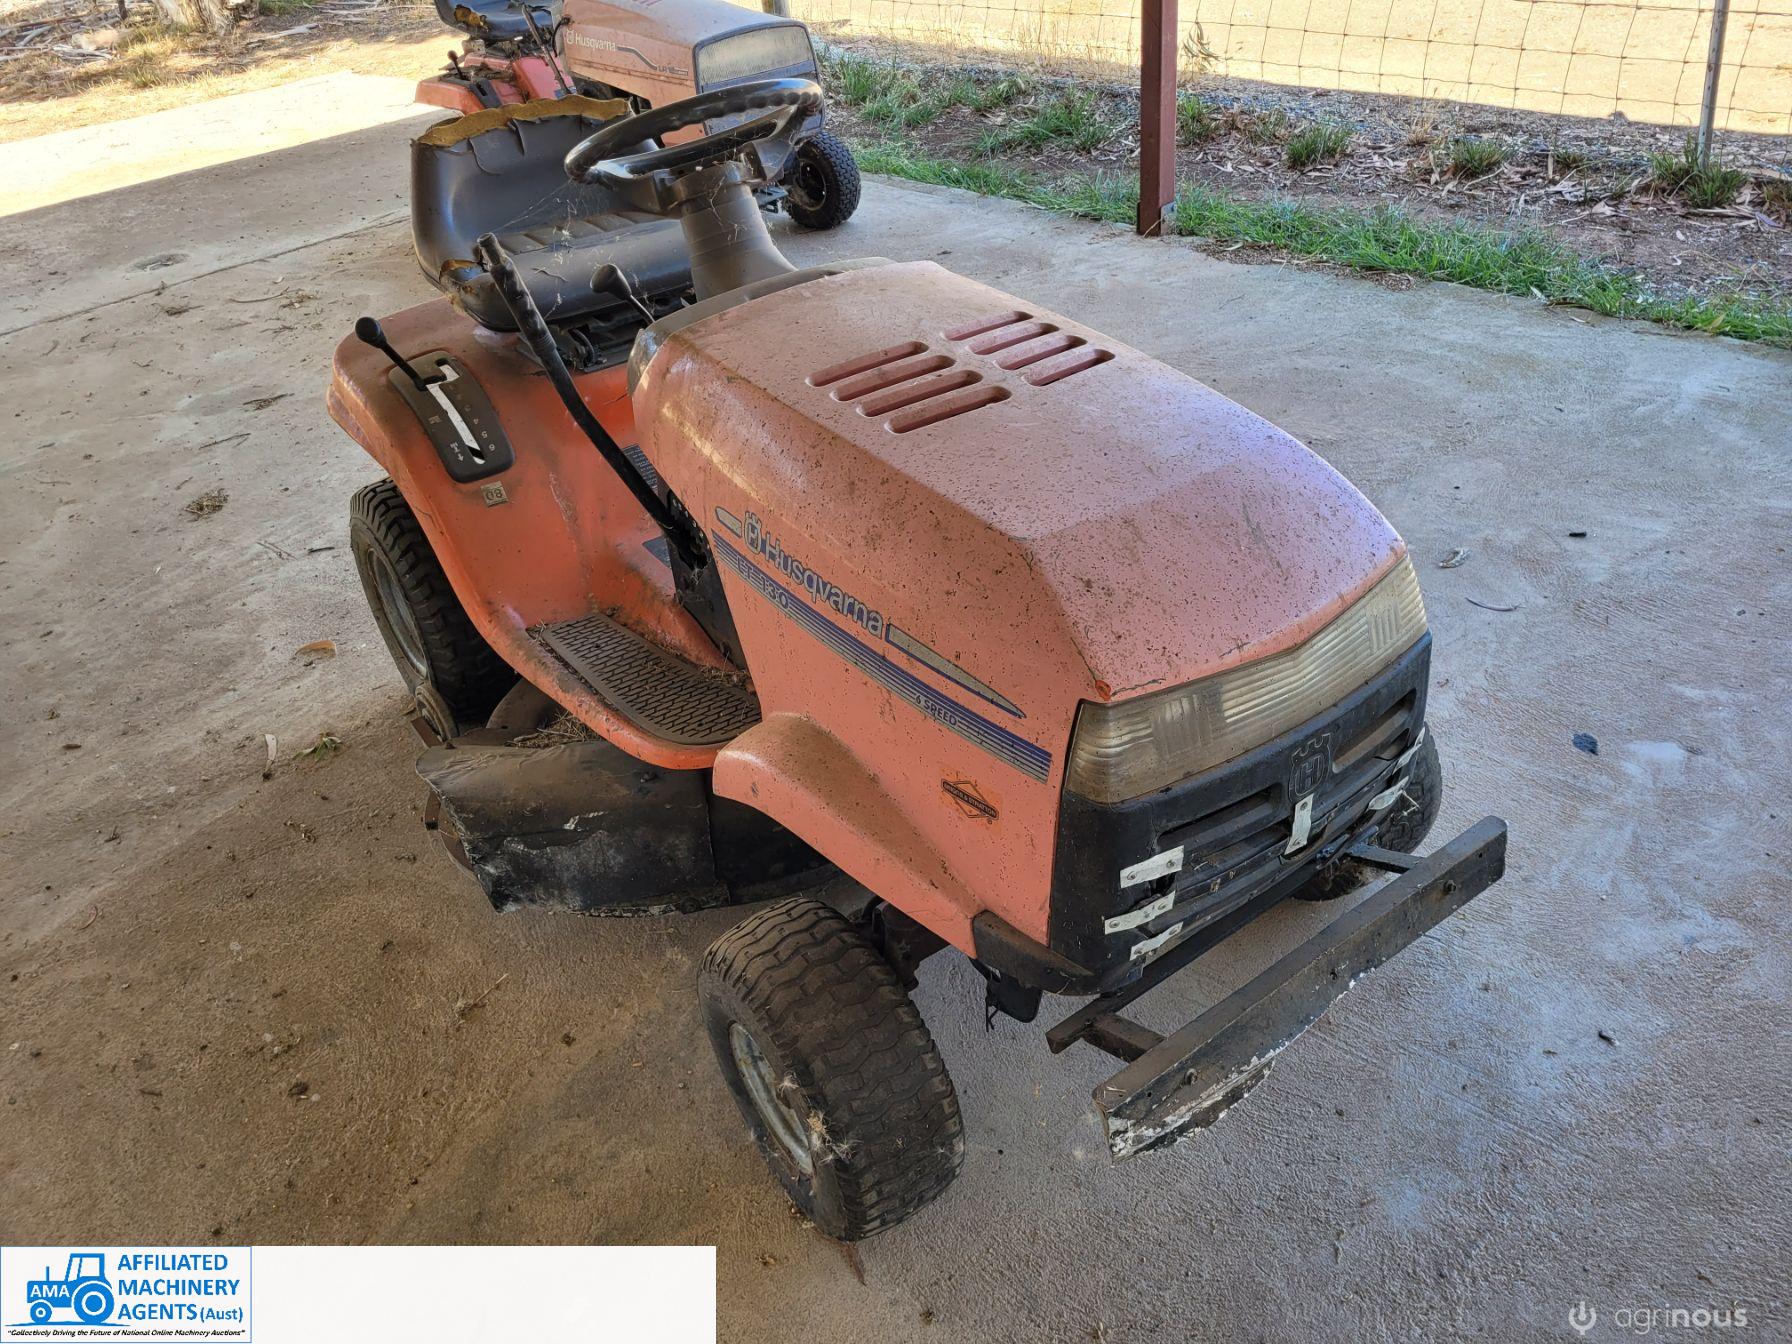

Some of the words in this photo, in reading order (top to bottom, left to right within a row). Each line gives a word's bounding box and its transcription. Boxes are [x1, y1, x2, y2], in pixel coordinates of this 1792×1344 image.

[575, 33, 616, 51] Husqvarna
[760, 575, 789, 609] 130
[765, 530, 884, 640] Husqvarna
[915, 694, 922, 705] 6
[924, 699, 957, 726] SPEED
